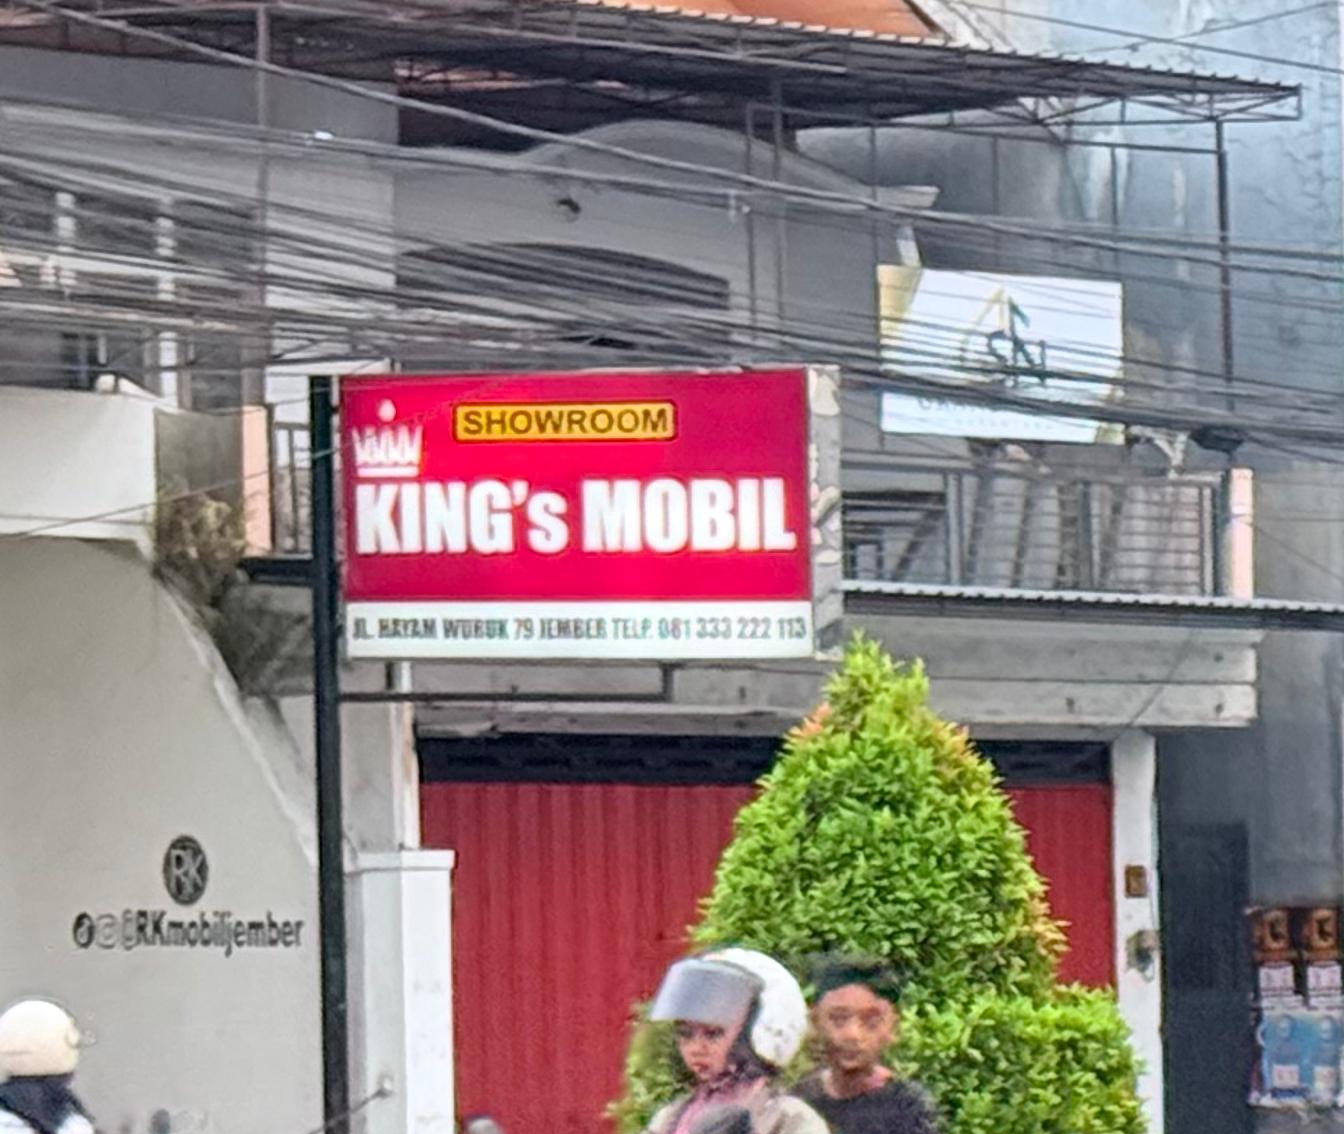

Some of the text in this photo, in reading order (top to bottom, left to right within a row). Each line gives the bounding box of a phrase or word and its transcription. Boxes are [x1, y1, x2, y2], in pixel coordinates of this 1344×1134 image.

[462, 408, 669, 436] SHOWROOM
[355, 477, 798, 555] KING's MOBIL
[378, 617, 437, 640] HAYAM
[442, 617, 509, 640] WURUK
[514, 617, 535, 640] 79
[538, 617, 608, 640] JEMBER
[658, 617, 690, 640] 081
[695, 617, 732, 640] 333
[737, 617, 771, 640] 222
